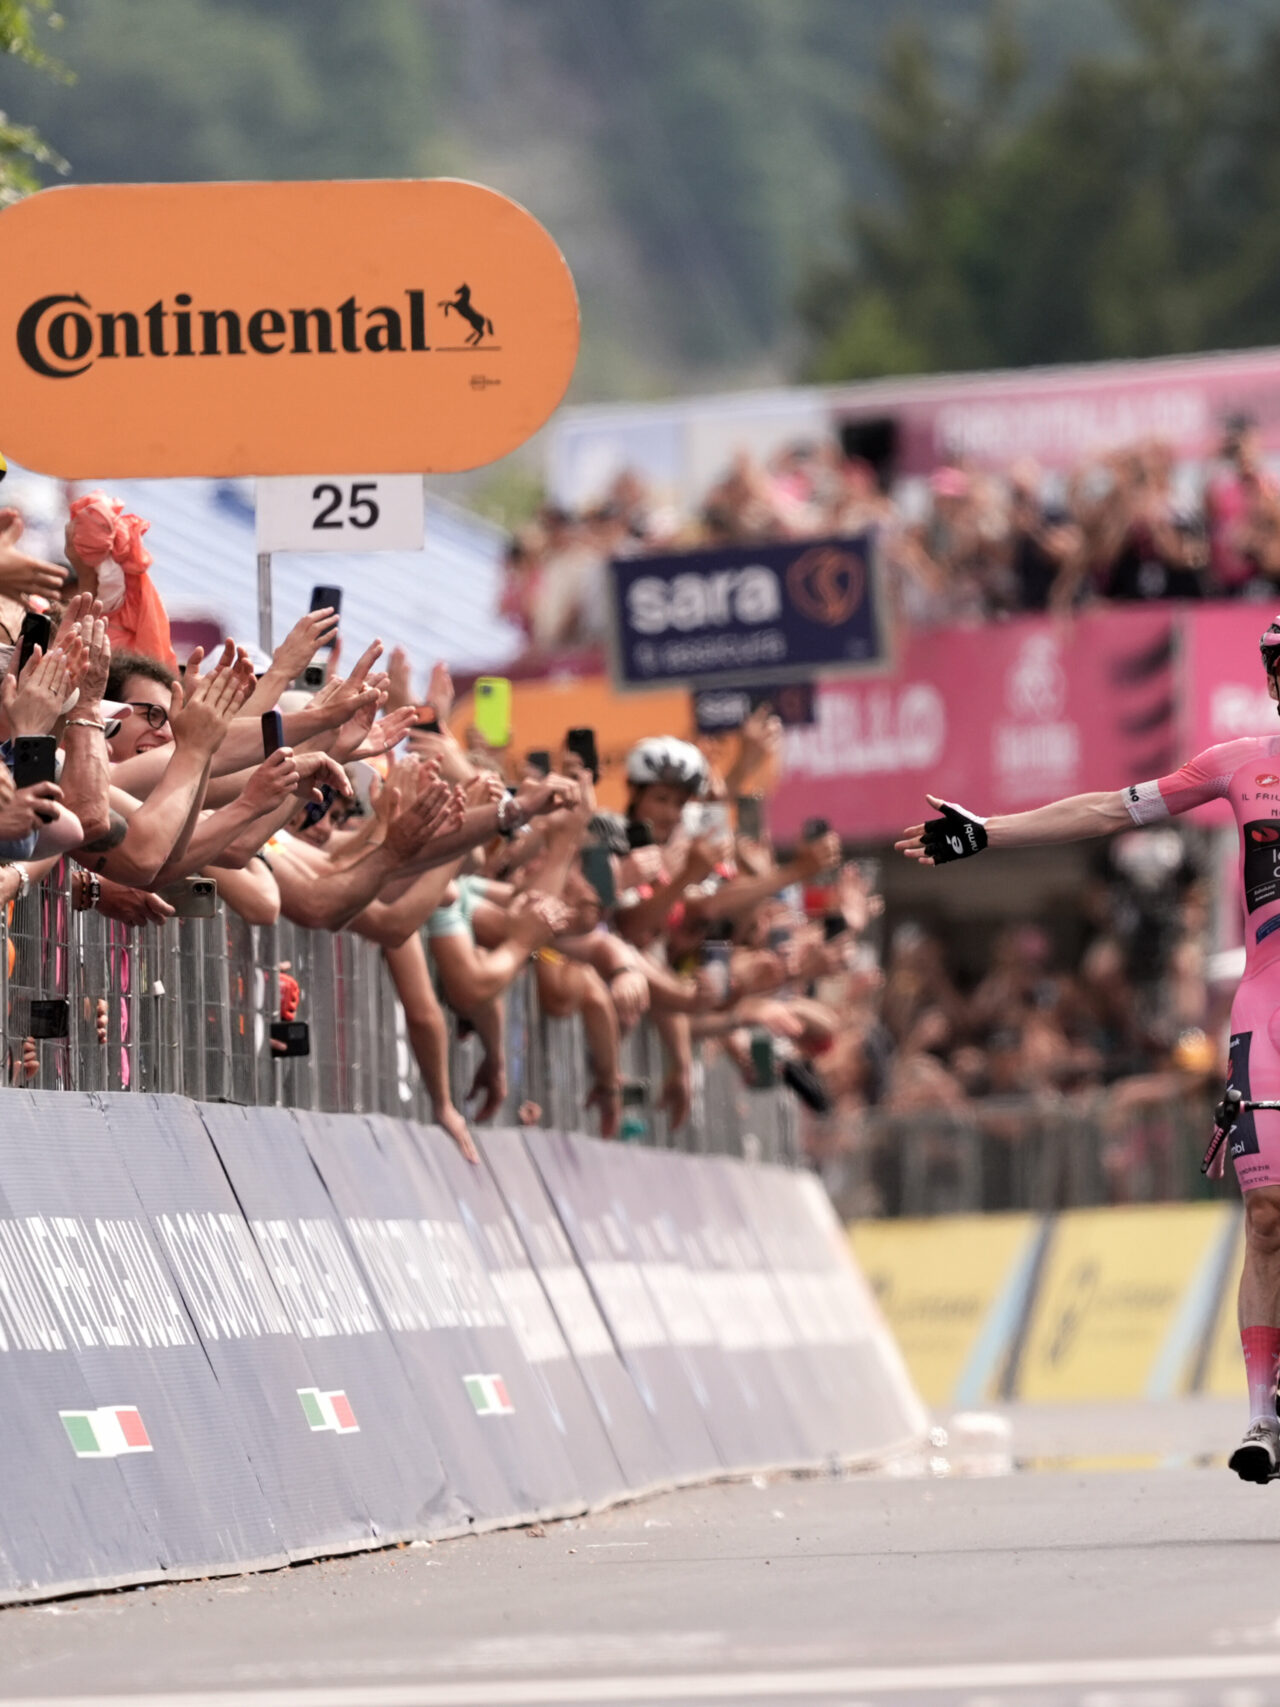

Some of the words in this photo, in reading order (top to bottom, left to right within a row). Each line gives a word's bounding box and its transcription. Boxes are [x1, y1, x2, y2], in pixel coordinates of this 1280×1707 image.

[17, 289, 431, 378] Continental
[312, 484, 379, 529] 25
[628, 565, 780, 634] sara
[16, 1211, 140, 1353] VENEZIA
[95, 1217, 195, 1348] GIULIA
[155, 1213, 219, 1341] IO
[175, 1209, 262, 1340] SONO
